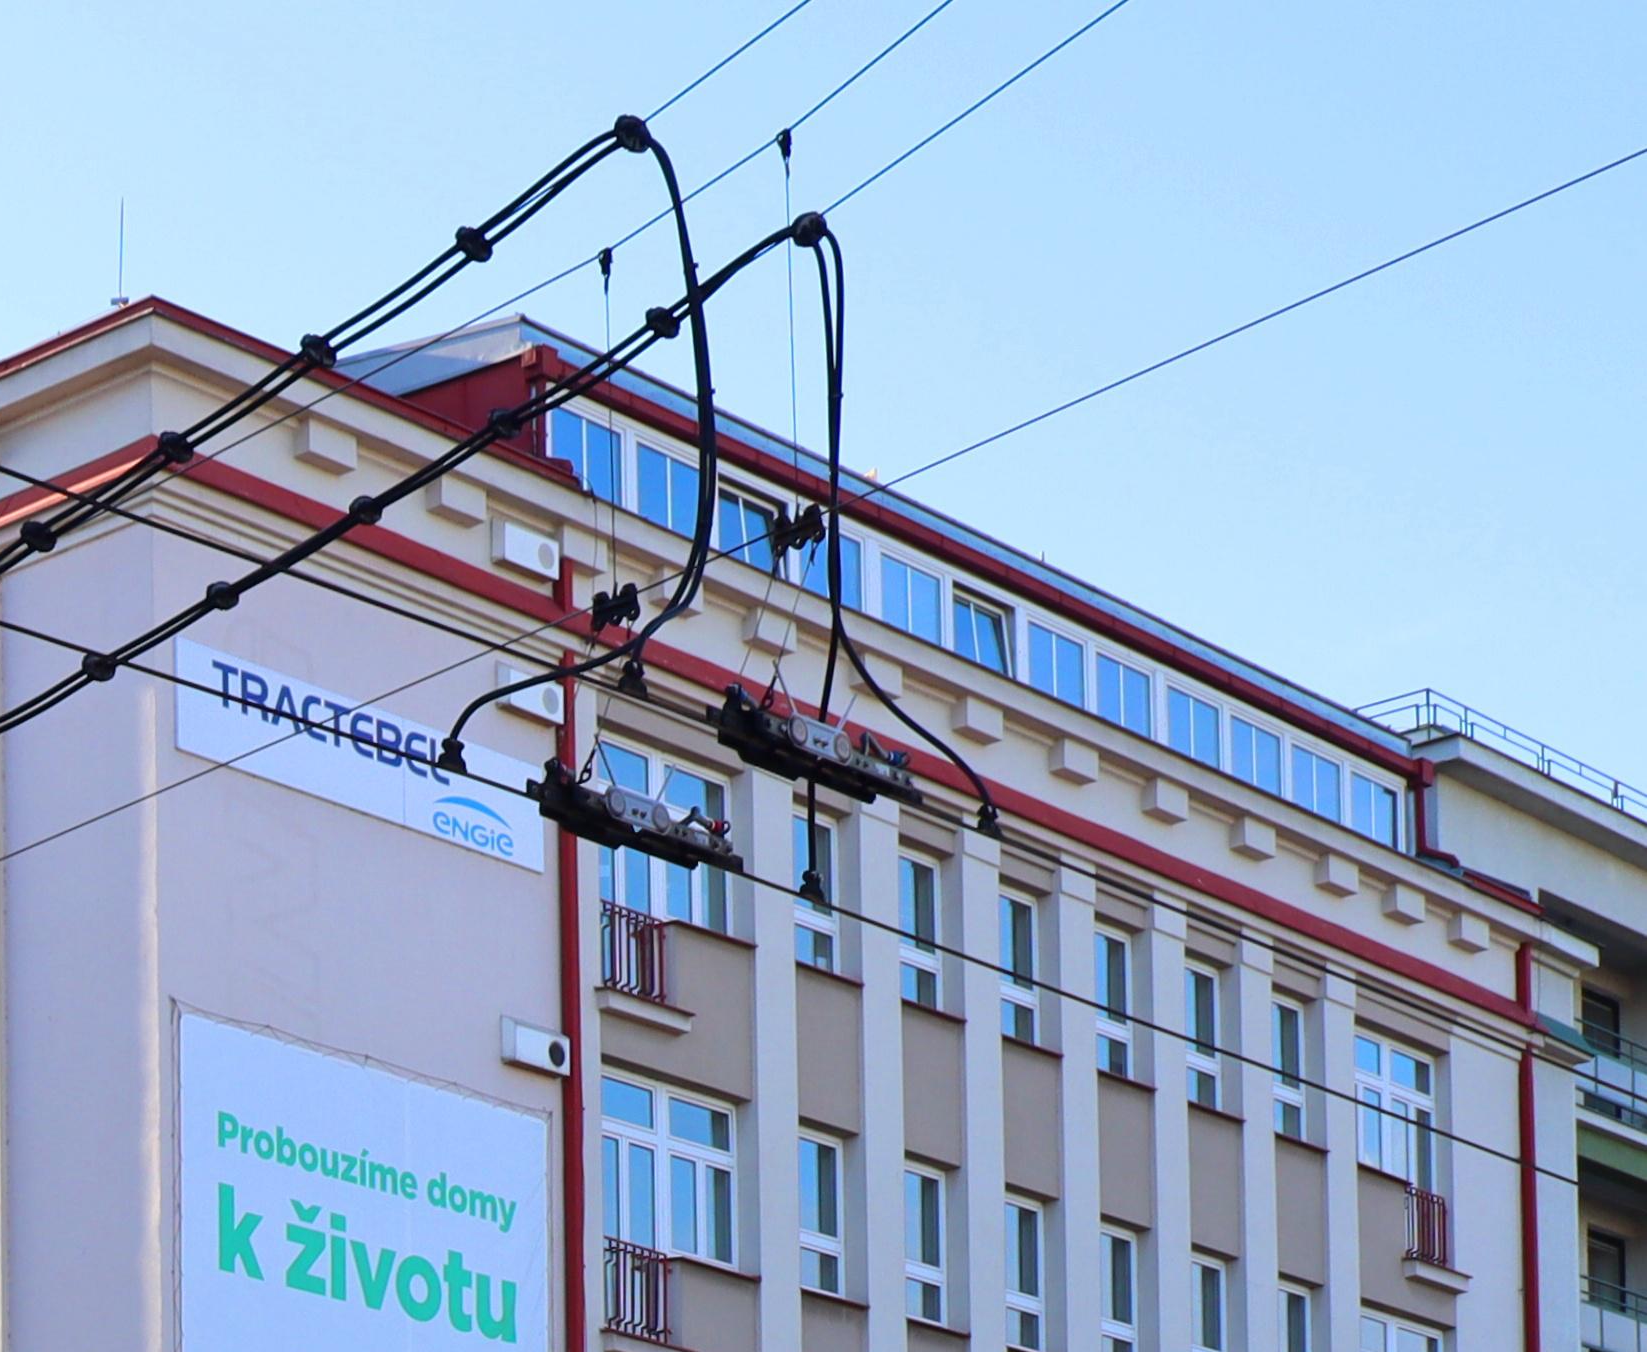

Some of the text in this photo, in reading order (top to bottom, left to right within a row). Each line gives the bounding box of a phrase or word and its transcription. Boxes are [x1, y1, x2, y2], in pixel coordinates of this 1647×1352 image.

[212, 659, 450, 786] TRACTEBEL
[217, 1111, 517, 1233] Probouzíme domy
[218, 1182, 518, 1345] k životu
